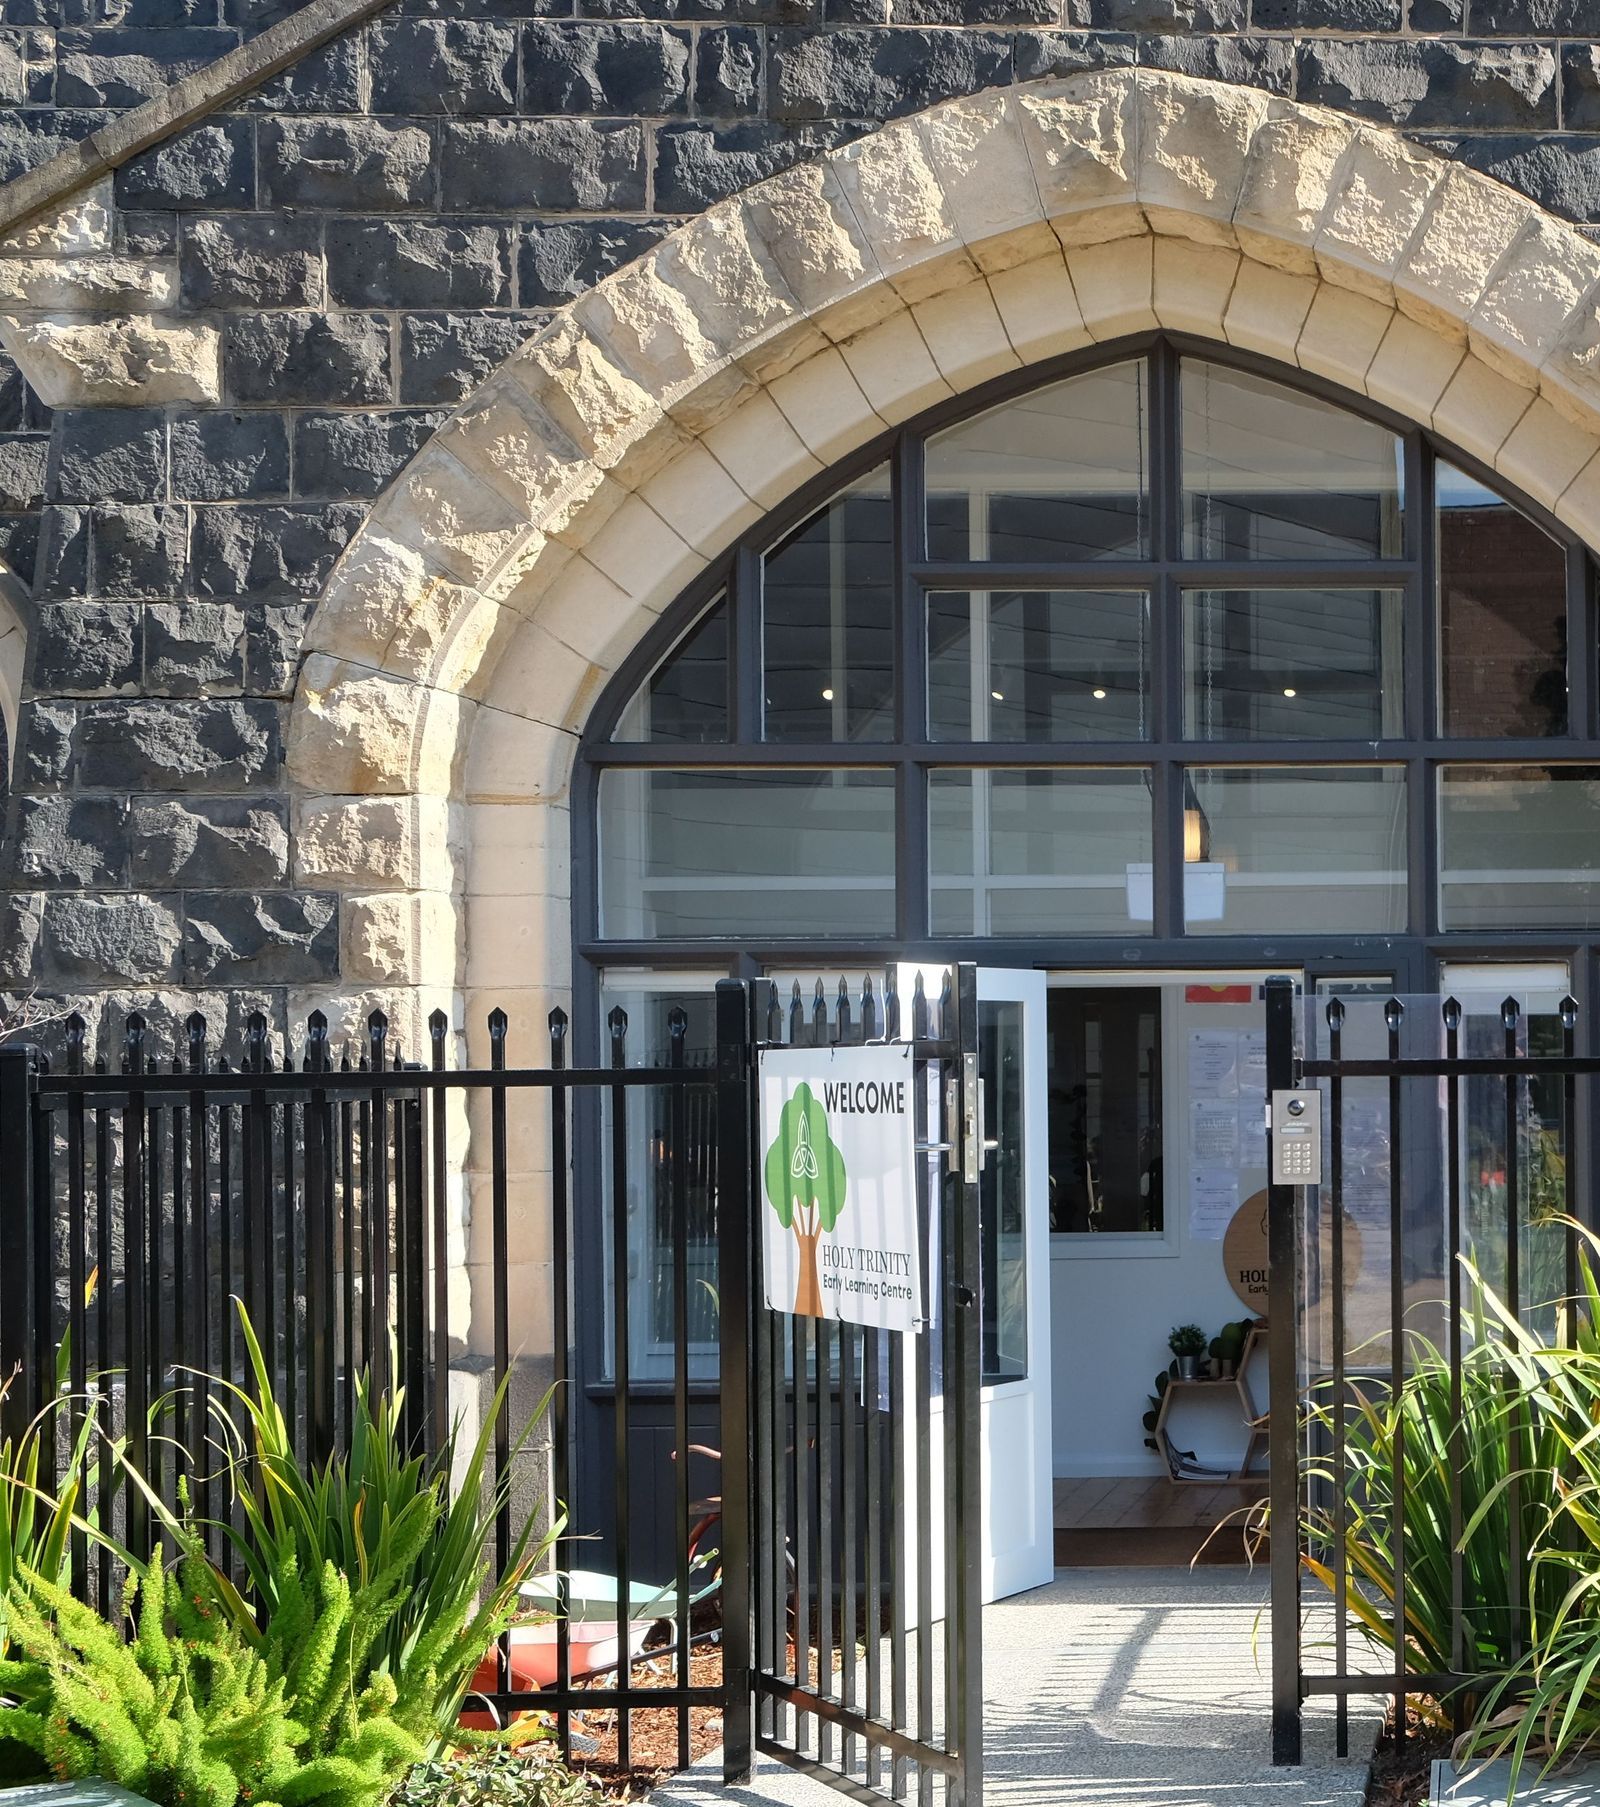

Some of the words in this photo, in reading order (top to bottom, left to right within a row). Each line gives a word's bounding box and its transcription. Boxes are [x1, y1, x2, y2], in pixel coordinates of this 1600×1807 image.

[823, 1081, 905, 1114] WELCOME
[823, 1244, 855, 1270] HOLY
[857, 1248, 911, 1277] TRINITY
[823, 1273, 843, 1296] Early
[844, 1276, 879, 1301] Learning
[880, 1281, 913, 1300] Centre
[1240, 1269, 1268, 1283] HOL
